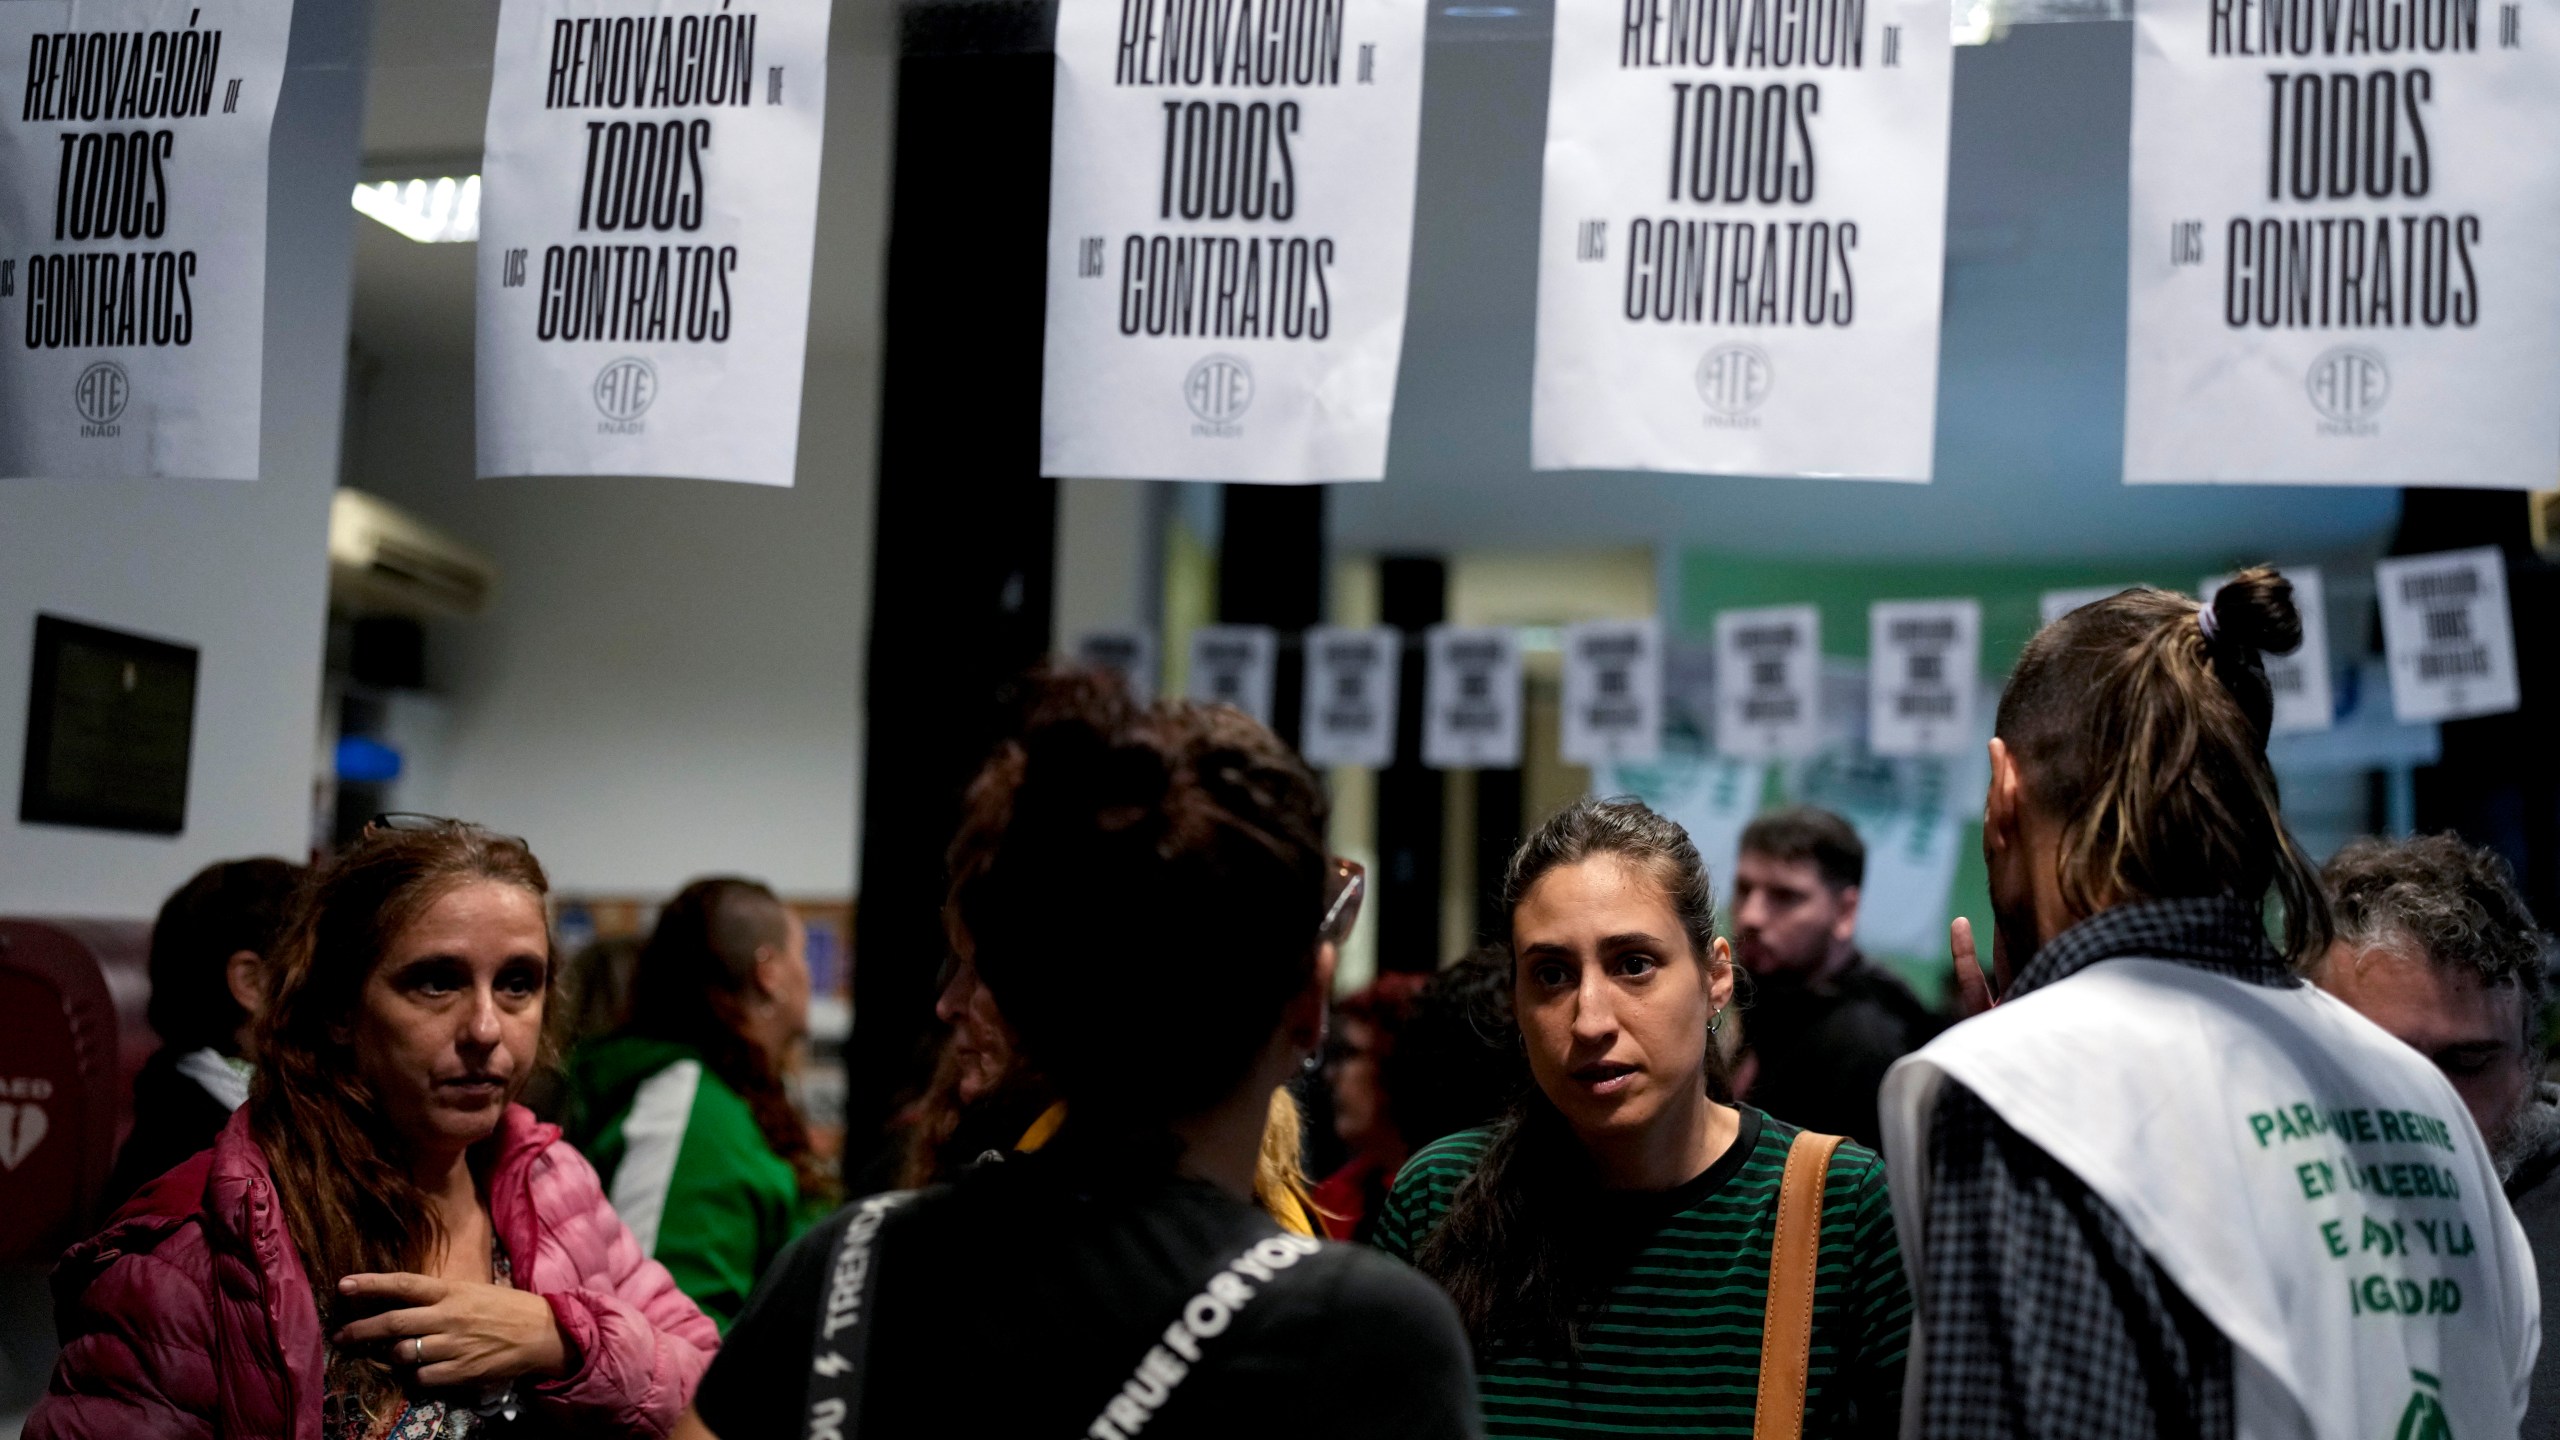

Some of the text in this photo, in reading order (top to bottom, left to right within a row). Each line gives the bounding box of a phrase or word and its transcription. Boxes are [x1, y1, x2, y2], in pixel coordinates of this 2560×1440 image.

[22, 8, 243, 122] RENOVACIÓN DE
[546, 0, 784, 109] RENOVACIÓN DE
[1357, 43, 1376, 84] DE
[55, 130, 174, 241] TODOS
[578, 119, 711, 232] TODOS
[1161, 101, 1299, 220] TODOS
[1668, 82, 1820, 205] TODOS
[2266, 68, 2432, 202] TODOS
[0, 250, 197, 350] OS CONTRATOS
[503, 245, 738, 343] LOS CONTRATOS
[1078, 234, 1334, 340] LOS CONTRATOS
[1577, 218, 1858, 327] LOS CONTRATOS
[2171, 214, 2481, 328] LOS CONTRATOS
[79, 366, 124, 418] ATE
[599, 363, 650, 416] ATE
[1191, 362, 1247, 416] ATE
[1702, 350, 1762, 405] ATE
[2316, 354, 2379, 413] ATE
[80, 424, 121, 438] INADI
[2413, 1217, 2437, 1255] Y
[2444, 1219, 2476, 1258] LA
[1088, 1344, 1189, 1440] TRUE
[1162, 1270, 1257, 1362] FOR
